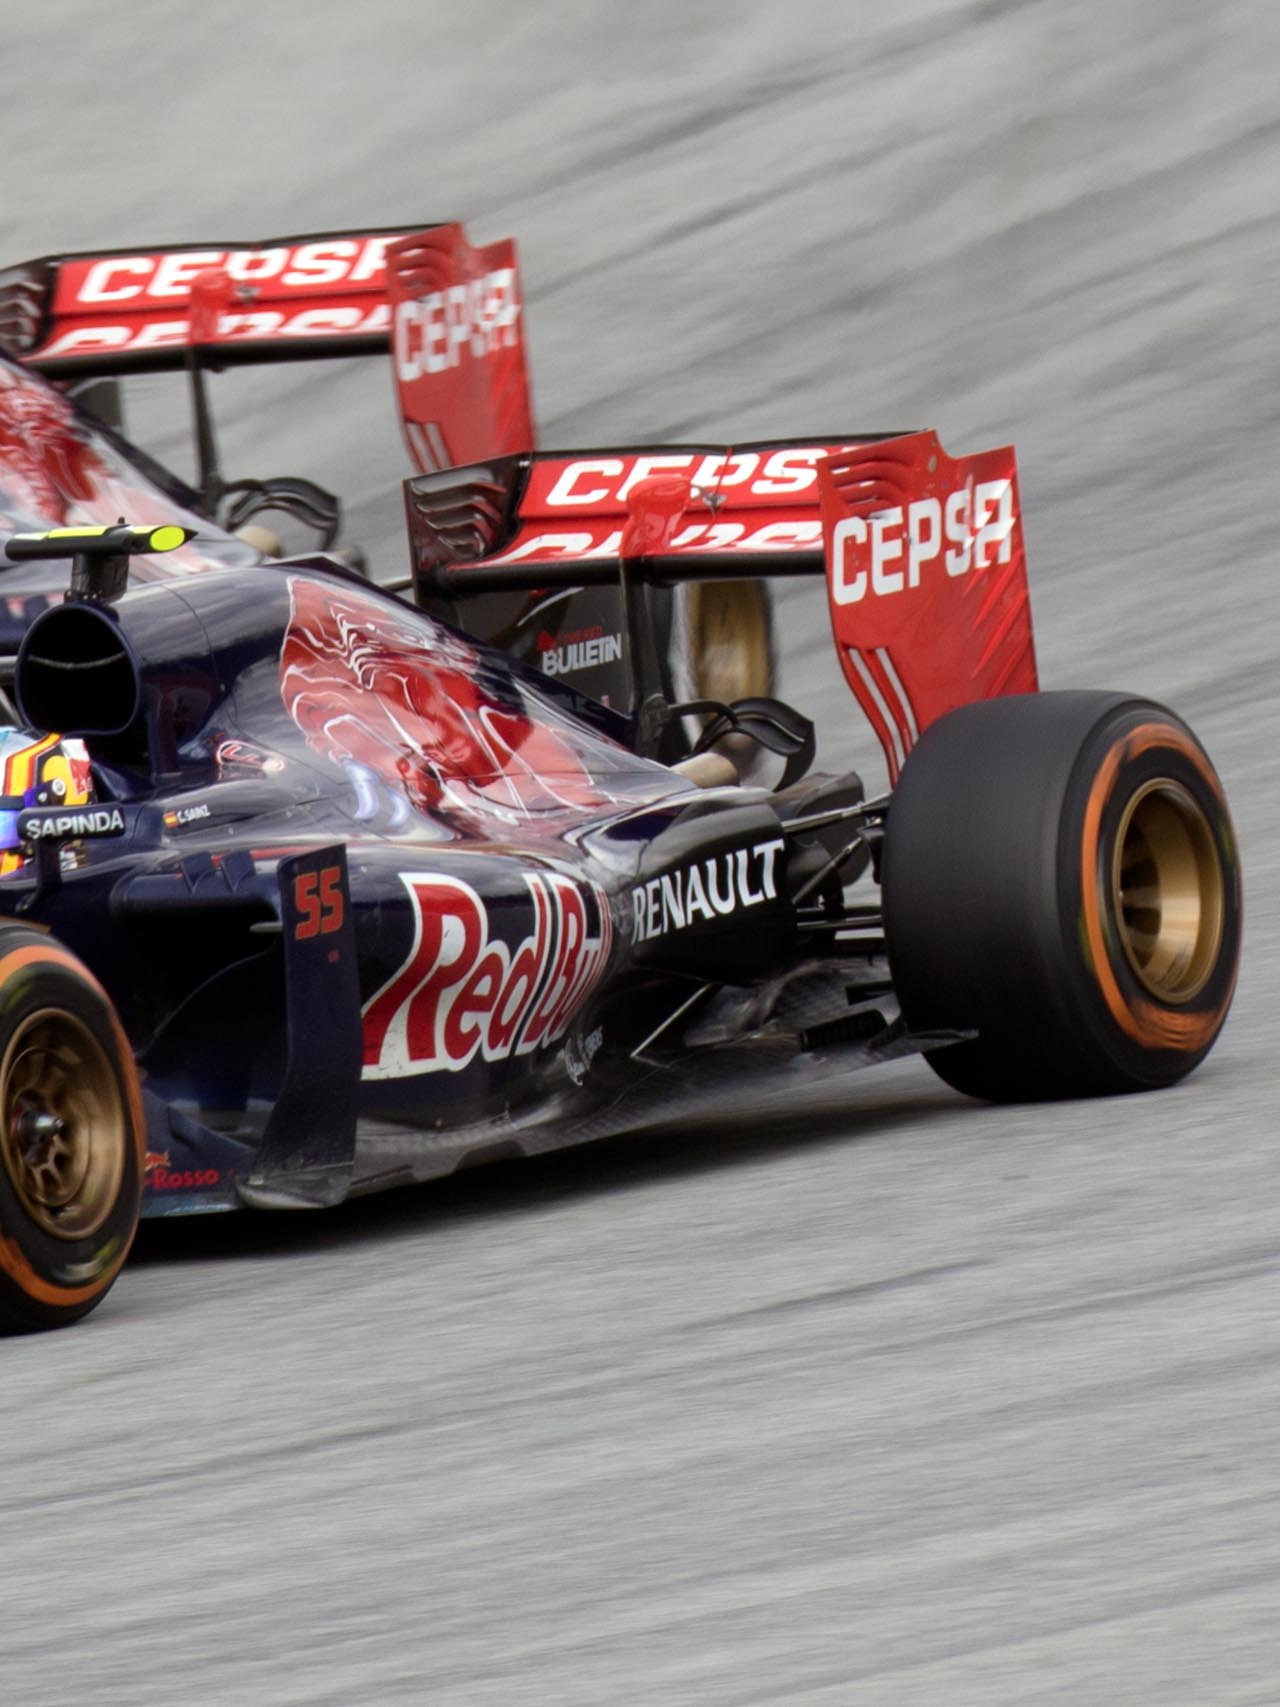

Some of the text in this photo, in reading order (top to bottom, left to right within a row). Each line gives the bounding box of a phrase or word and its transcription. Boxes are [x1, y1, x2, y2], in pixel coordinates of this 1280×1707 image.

[396, 268, 519, 381] CEPSA
[833, 479, 1015, 606] CEPSA
[26, 809, 124, 840] SAPINDA
[295, 866, 344, 941] 55
[631, 838, 785, 945] RENAULT
[361, 872, 550, 1081] Red
[152, 1167, 220, 1190] Rosso
